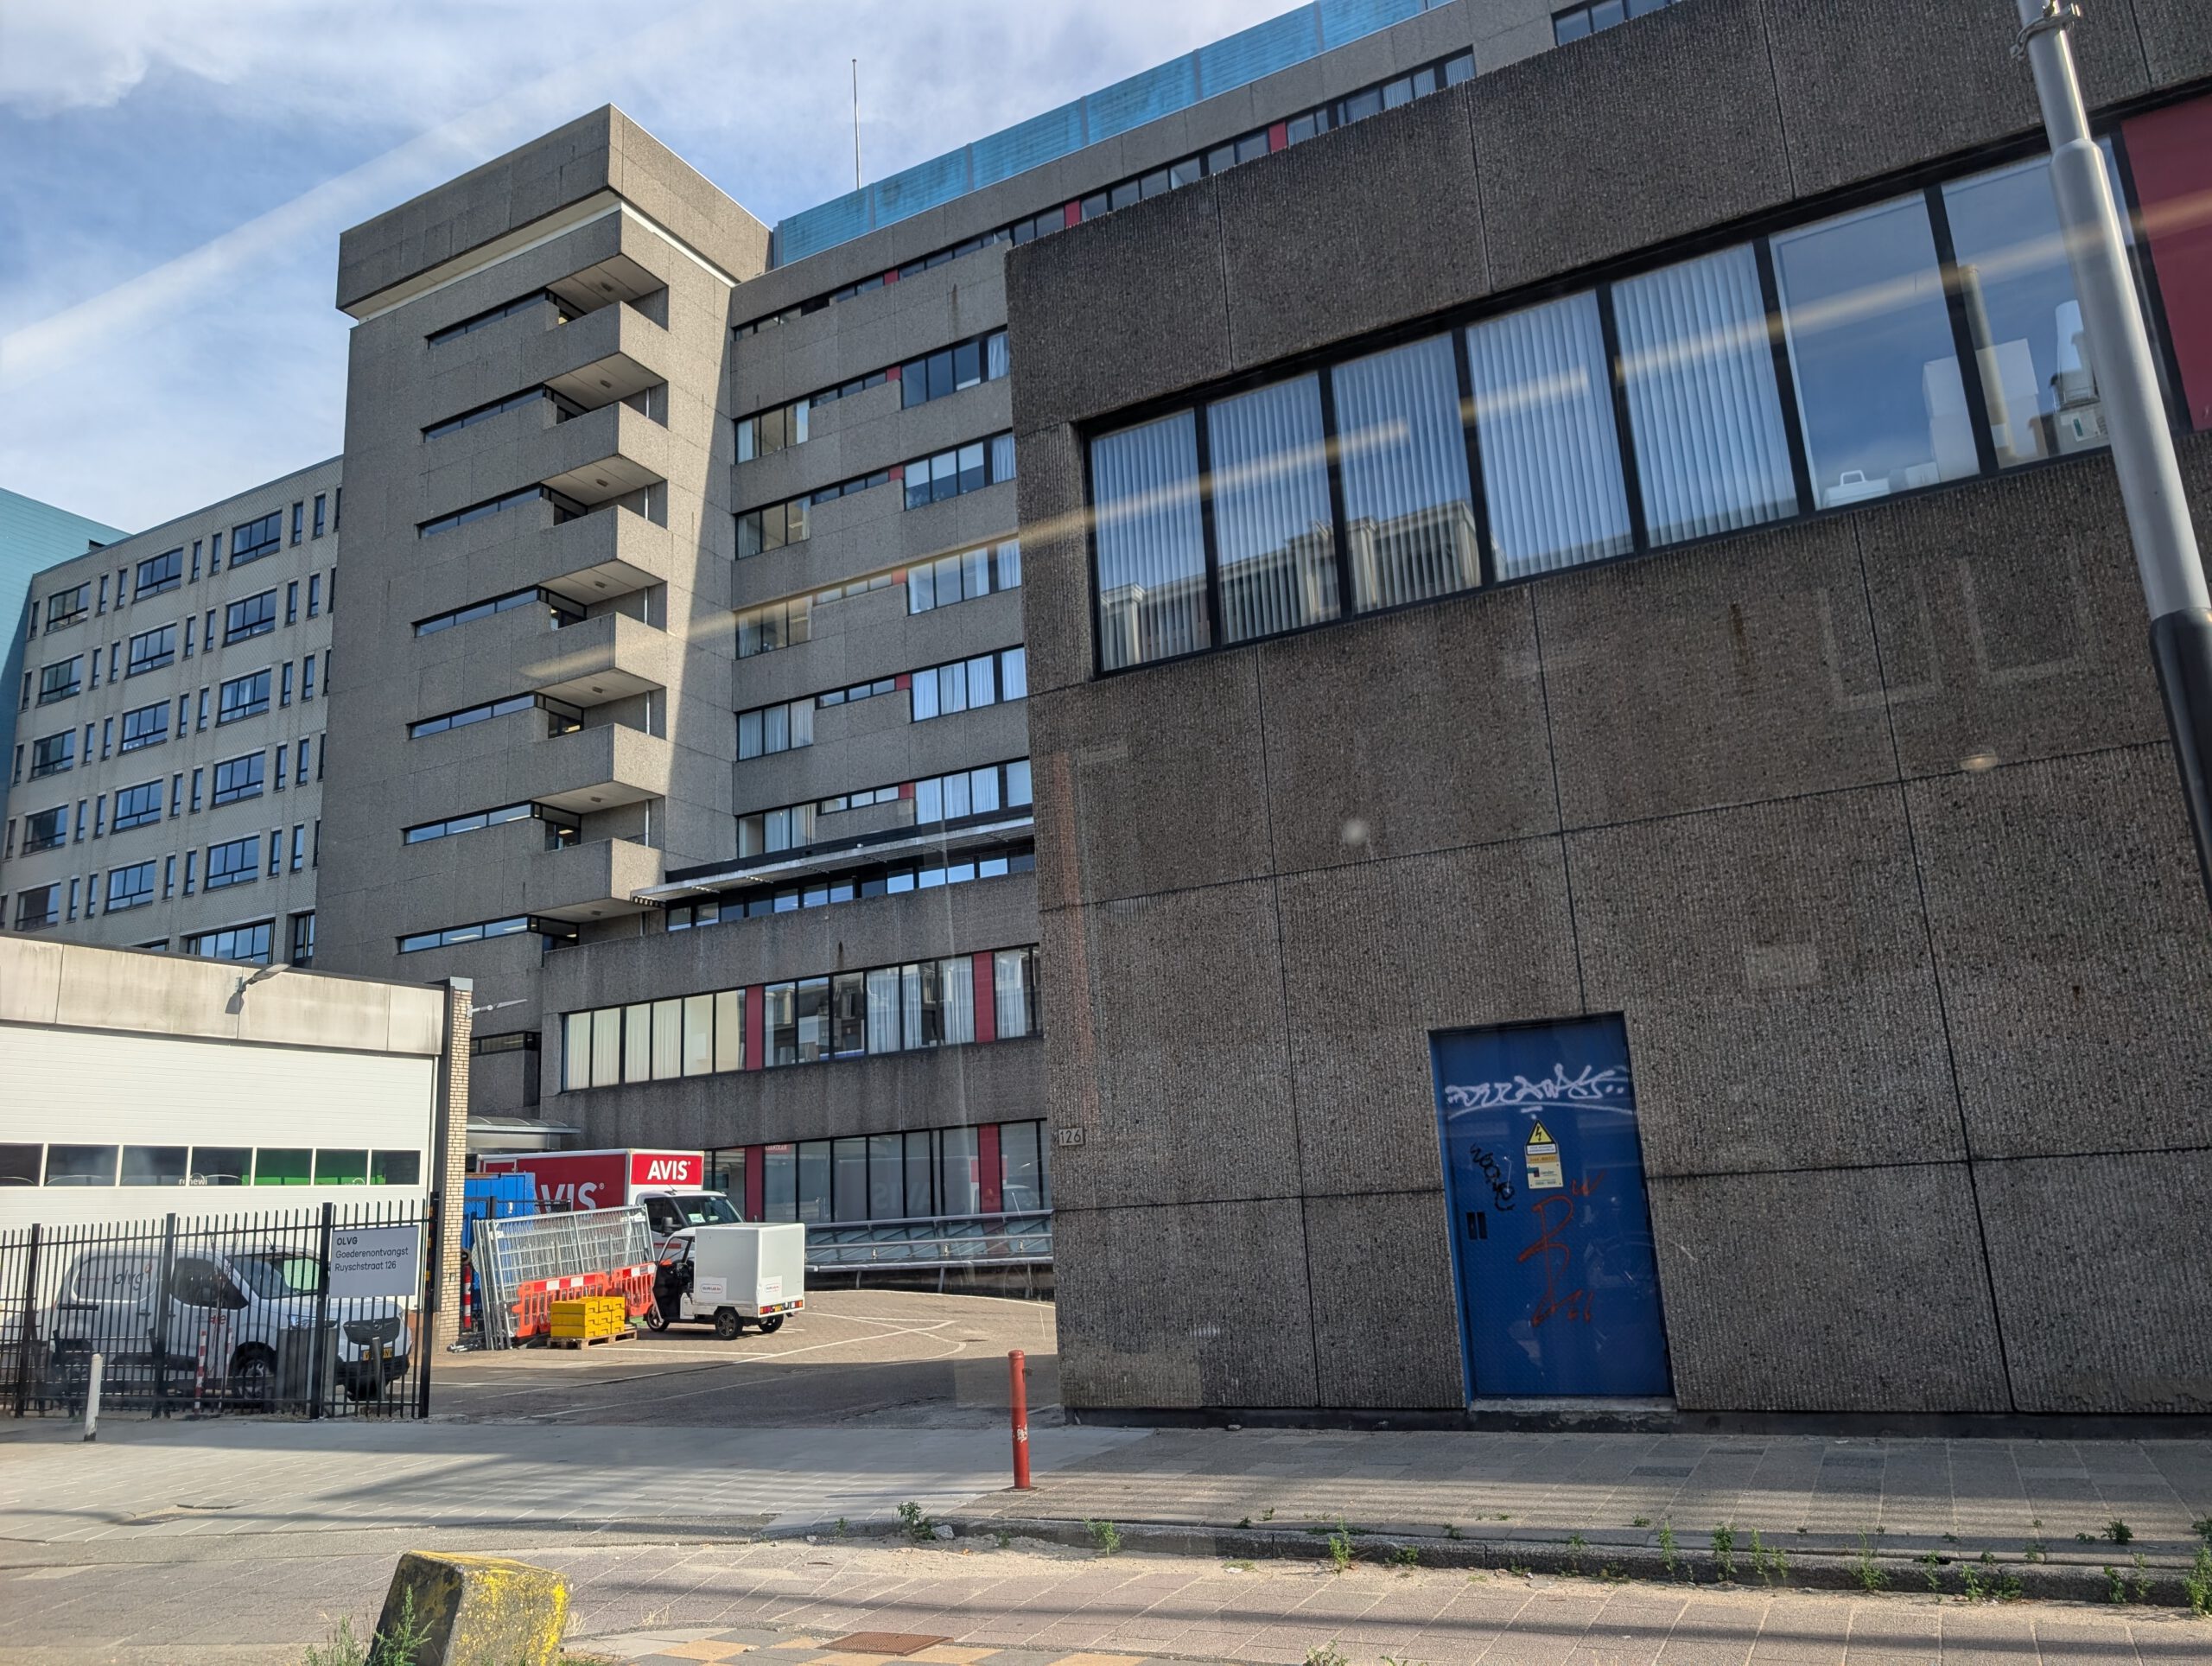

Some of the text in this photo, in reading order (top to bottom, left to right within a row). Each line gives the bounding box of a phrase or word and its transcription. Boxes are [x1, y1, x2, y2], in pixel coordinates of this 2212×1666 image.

[1060, 1129, 1081, 1144] 126
[647, 1160, 688, 1180] AVIS
[336, 1237, 358, 1245] OLVG
[335, 1247, 409, 1258] Goederenontvangst
[334, 1261, 397, 1273] Ruyschstraat 126
